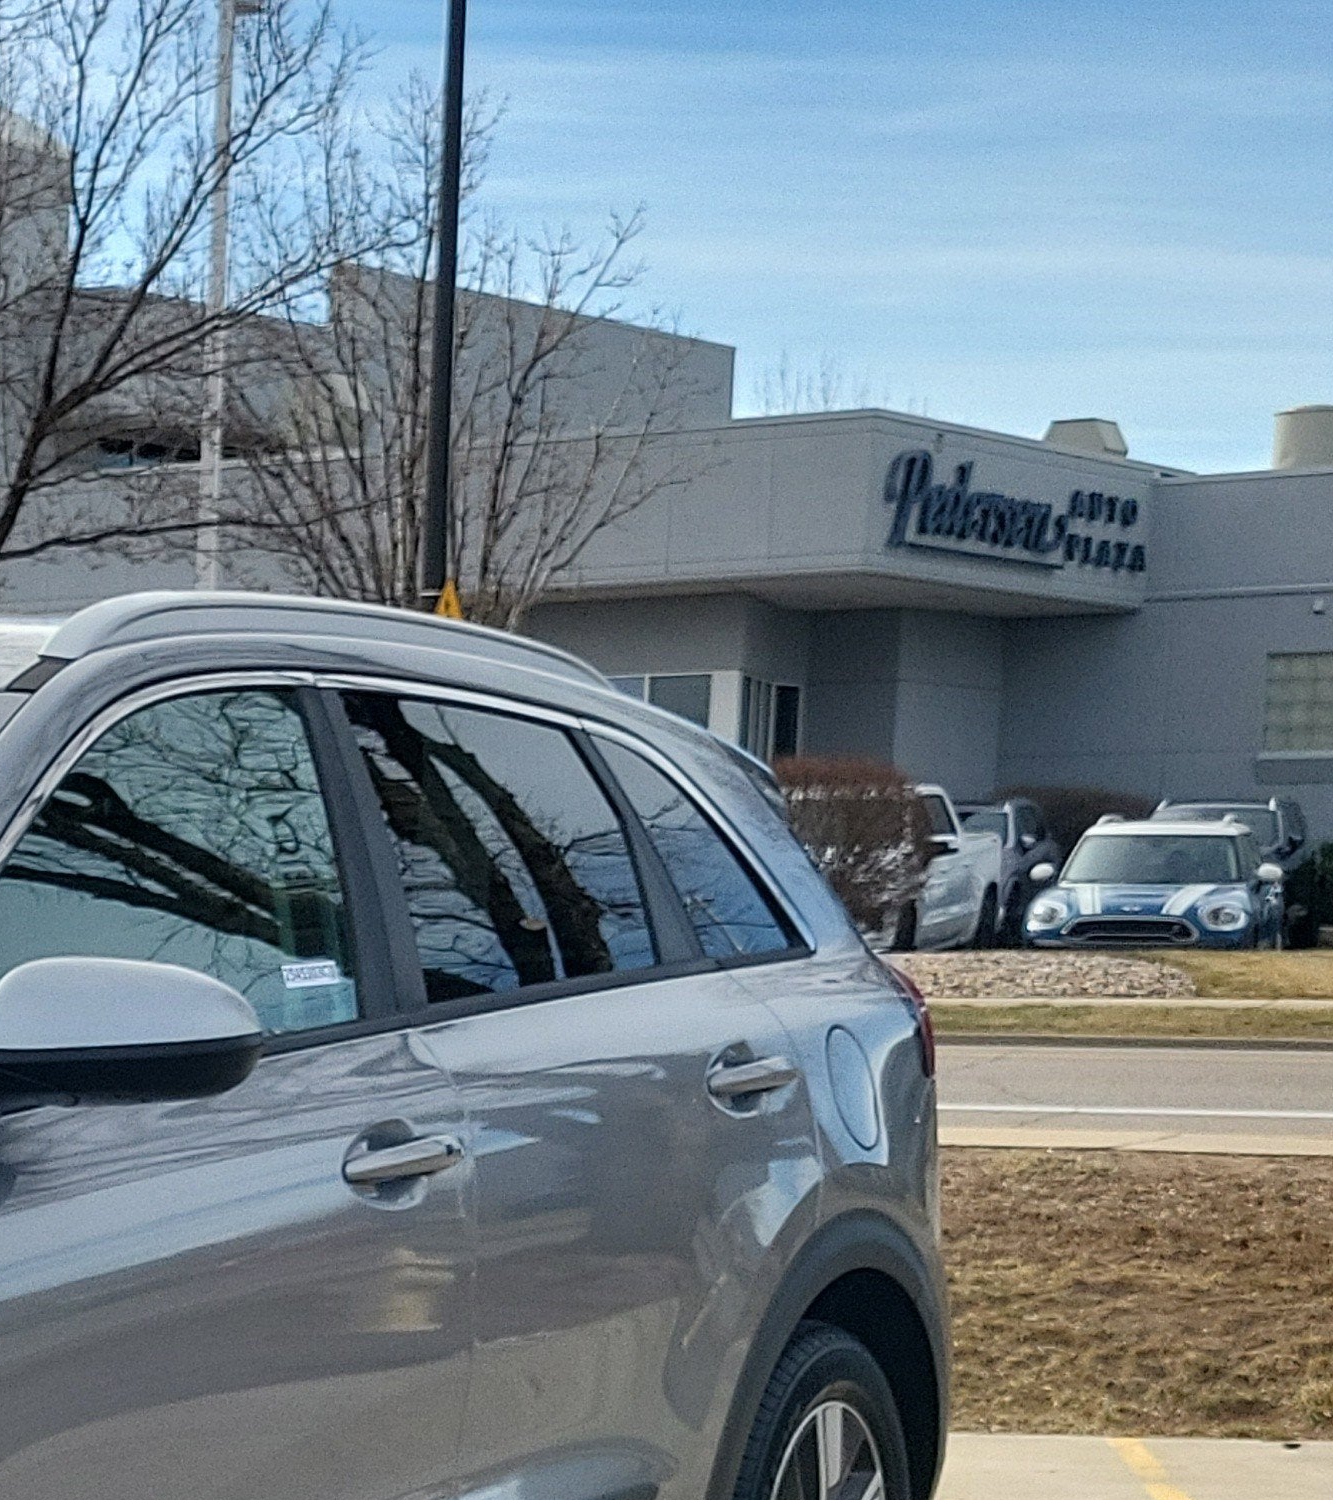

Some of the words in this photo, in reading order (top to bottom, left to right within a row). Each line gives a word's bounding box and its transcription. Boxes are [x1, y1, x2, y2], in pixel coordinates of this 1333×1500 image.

[885, 449, 1068, 552] Pedersen
[1068, 489, 1139, 527] AUTO
[1064, 532, 1147, 572] PLAZA
